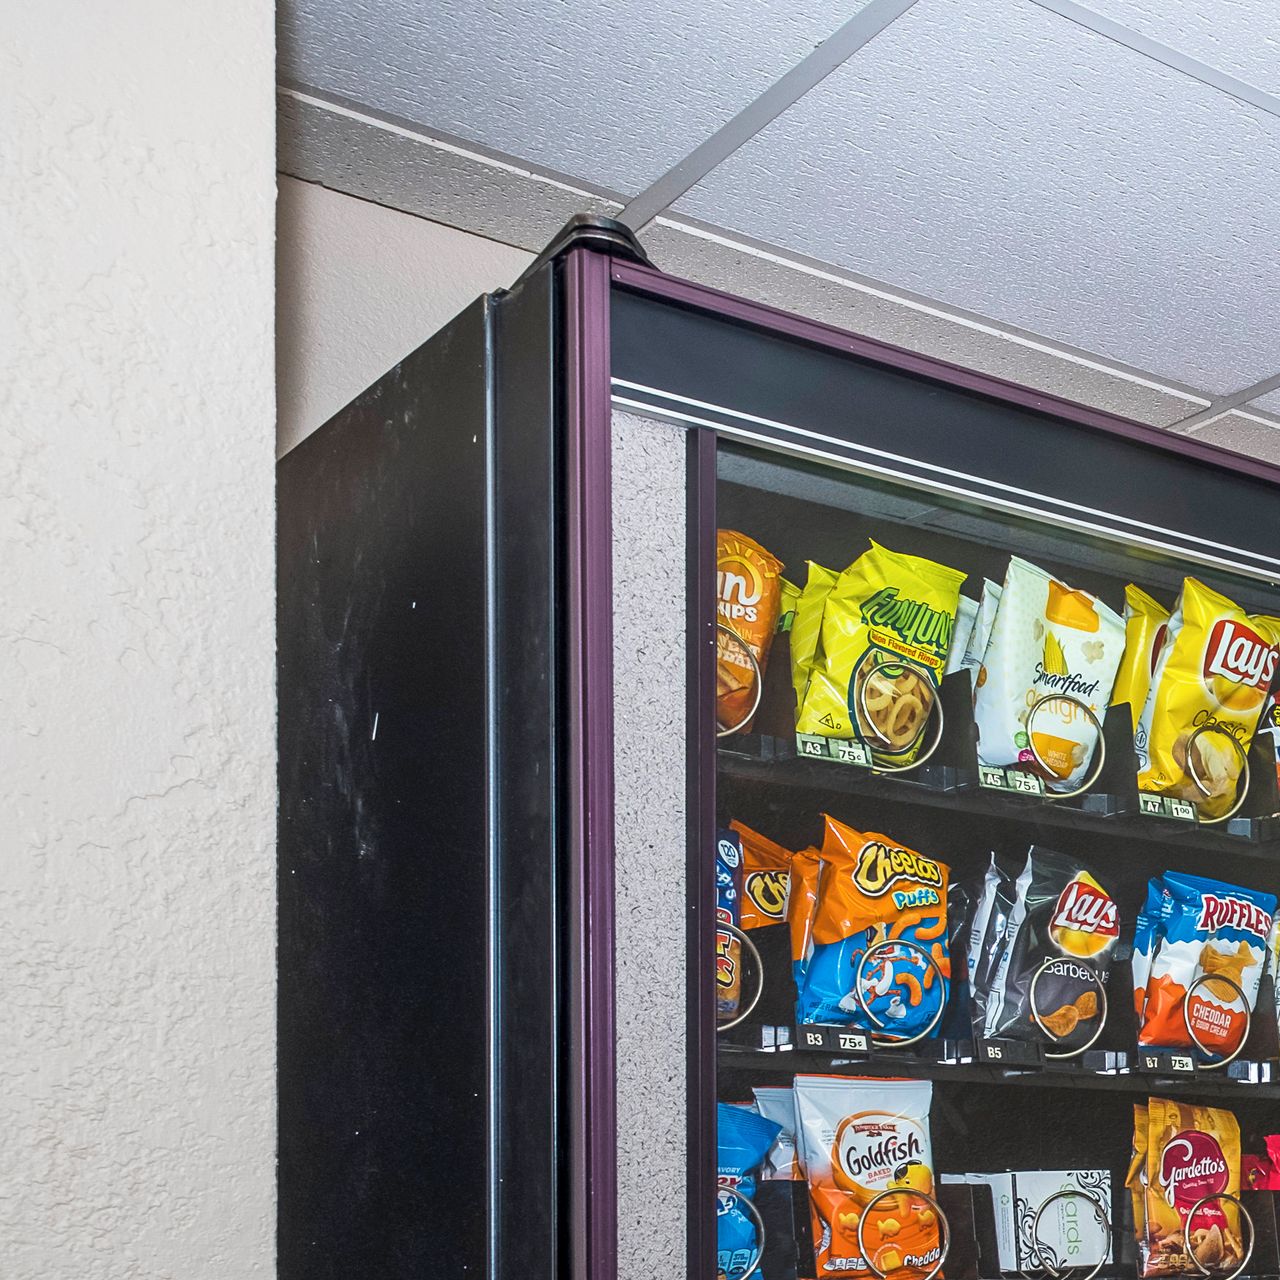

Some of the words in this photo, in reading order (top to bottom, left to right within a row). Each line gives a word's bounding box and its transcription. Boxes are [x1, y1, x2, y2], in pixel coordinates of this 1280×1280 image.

[917, 646, 940, 669] Rings
[1208, 623, 1280, 686] Lay's
[1032, 661, 1101, 698] Smartfood
[805, 742, 822, 756] A3
[838, 748, 862, 762] 75¢
[985, 774, 1001, 786] A5
[1016, 778, 1037, 792] 75¢
[1146, 801, 1160, 813] A7
[855, 843, 941, 893] Cheetos
[893, 888, 939, 909] Puffs
[1199, 893, 1273, 938] RUFFLES
[1192, 1003, 1232, 1027] CHEDDAR
[806, 1032, 823, 1046] B3
[840, 1036, 863, 1048] 75¢
[986, 1046, 1002, 1059] B5
[1145, 1056, 1158, 1068] B7
[846, 1132, 920, 1177] Goldfish
[867, 1167, 892, 1179] BAKED
[1159, 1138, 1226, 1208] Gardetto's
[903, 1247, 941, 1268] Chedda
